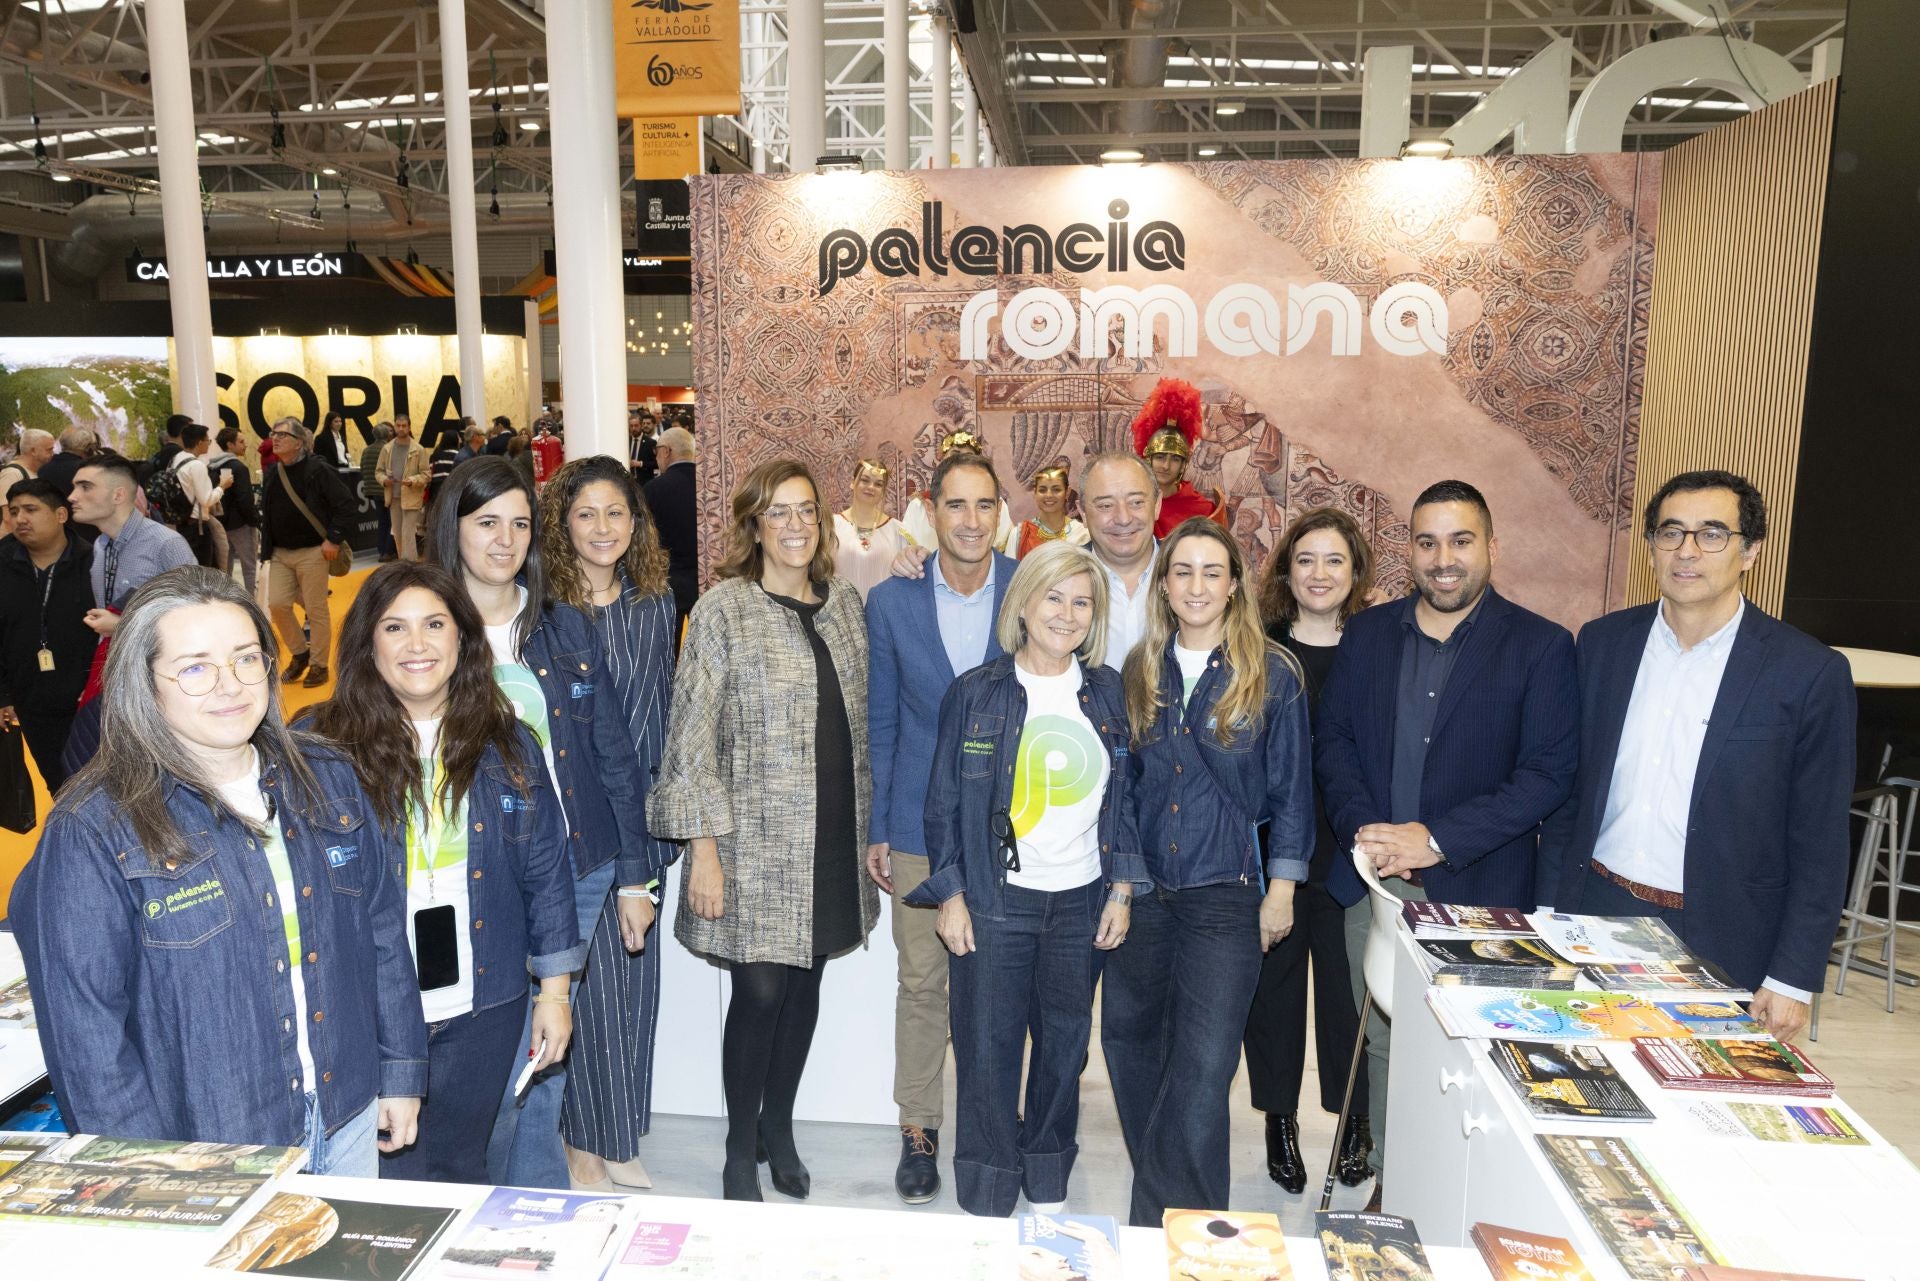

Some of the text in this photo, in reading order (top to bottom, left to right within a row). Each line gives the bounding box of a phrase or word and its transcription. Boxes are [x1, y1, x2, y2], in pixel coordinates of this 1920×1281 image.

[635, 14, 711, 25] FERIA DE
[635, 24, 711, 37] VALLADOLID
[642, 122, 676, 130] TURISMO
[642, 140, 694, 149] INTELIGENCIA
[664, 214, 686, 222] Junta
[645, 221, 691, 231] Castilla y Leó
[818, 197, 1186, 298] palencia
[136, 252, 342, 280] CALLA Y LEÓN
[959, 283, 1450, 361] romana
[166, 879, 221, 906] palencia
[168, 899, 198, 913] turismo
[83, 1206, 132, 1217] CERRATO
[145, 1207, 222, 1222] ENOTURISMO
[1366, 1219, 1404, 1230] PALENCIA
